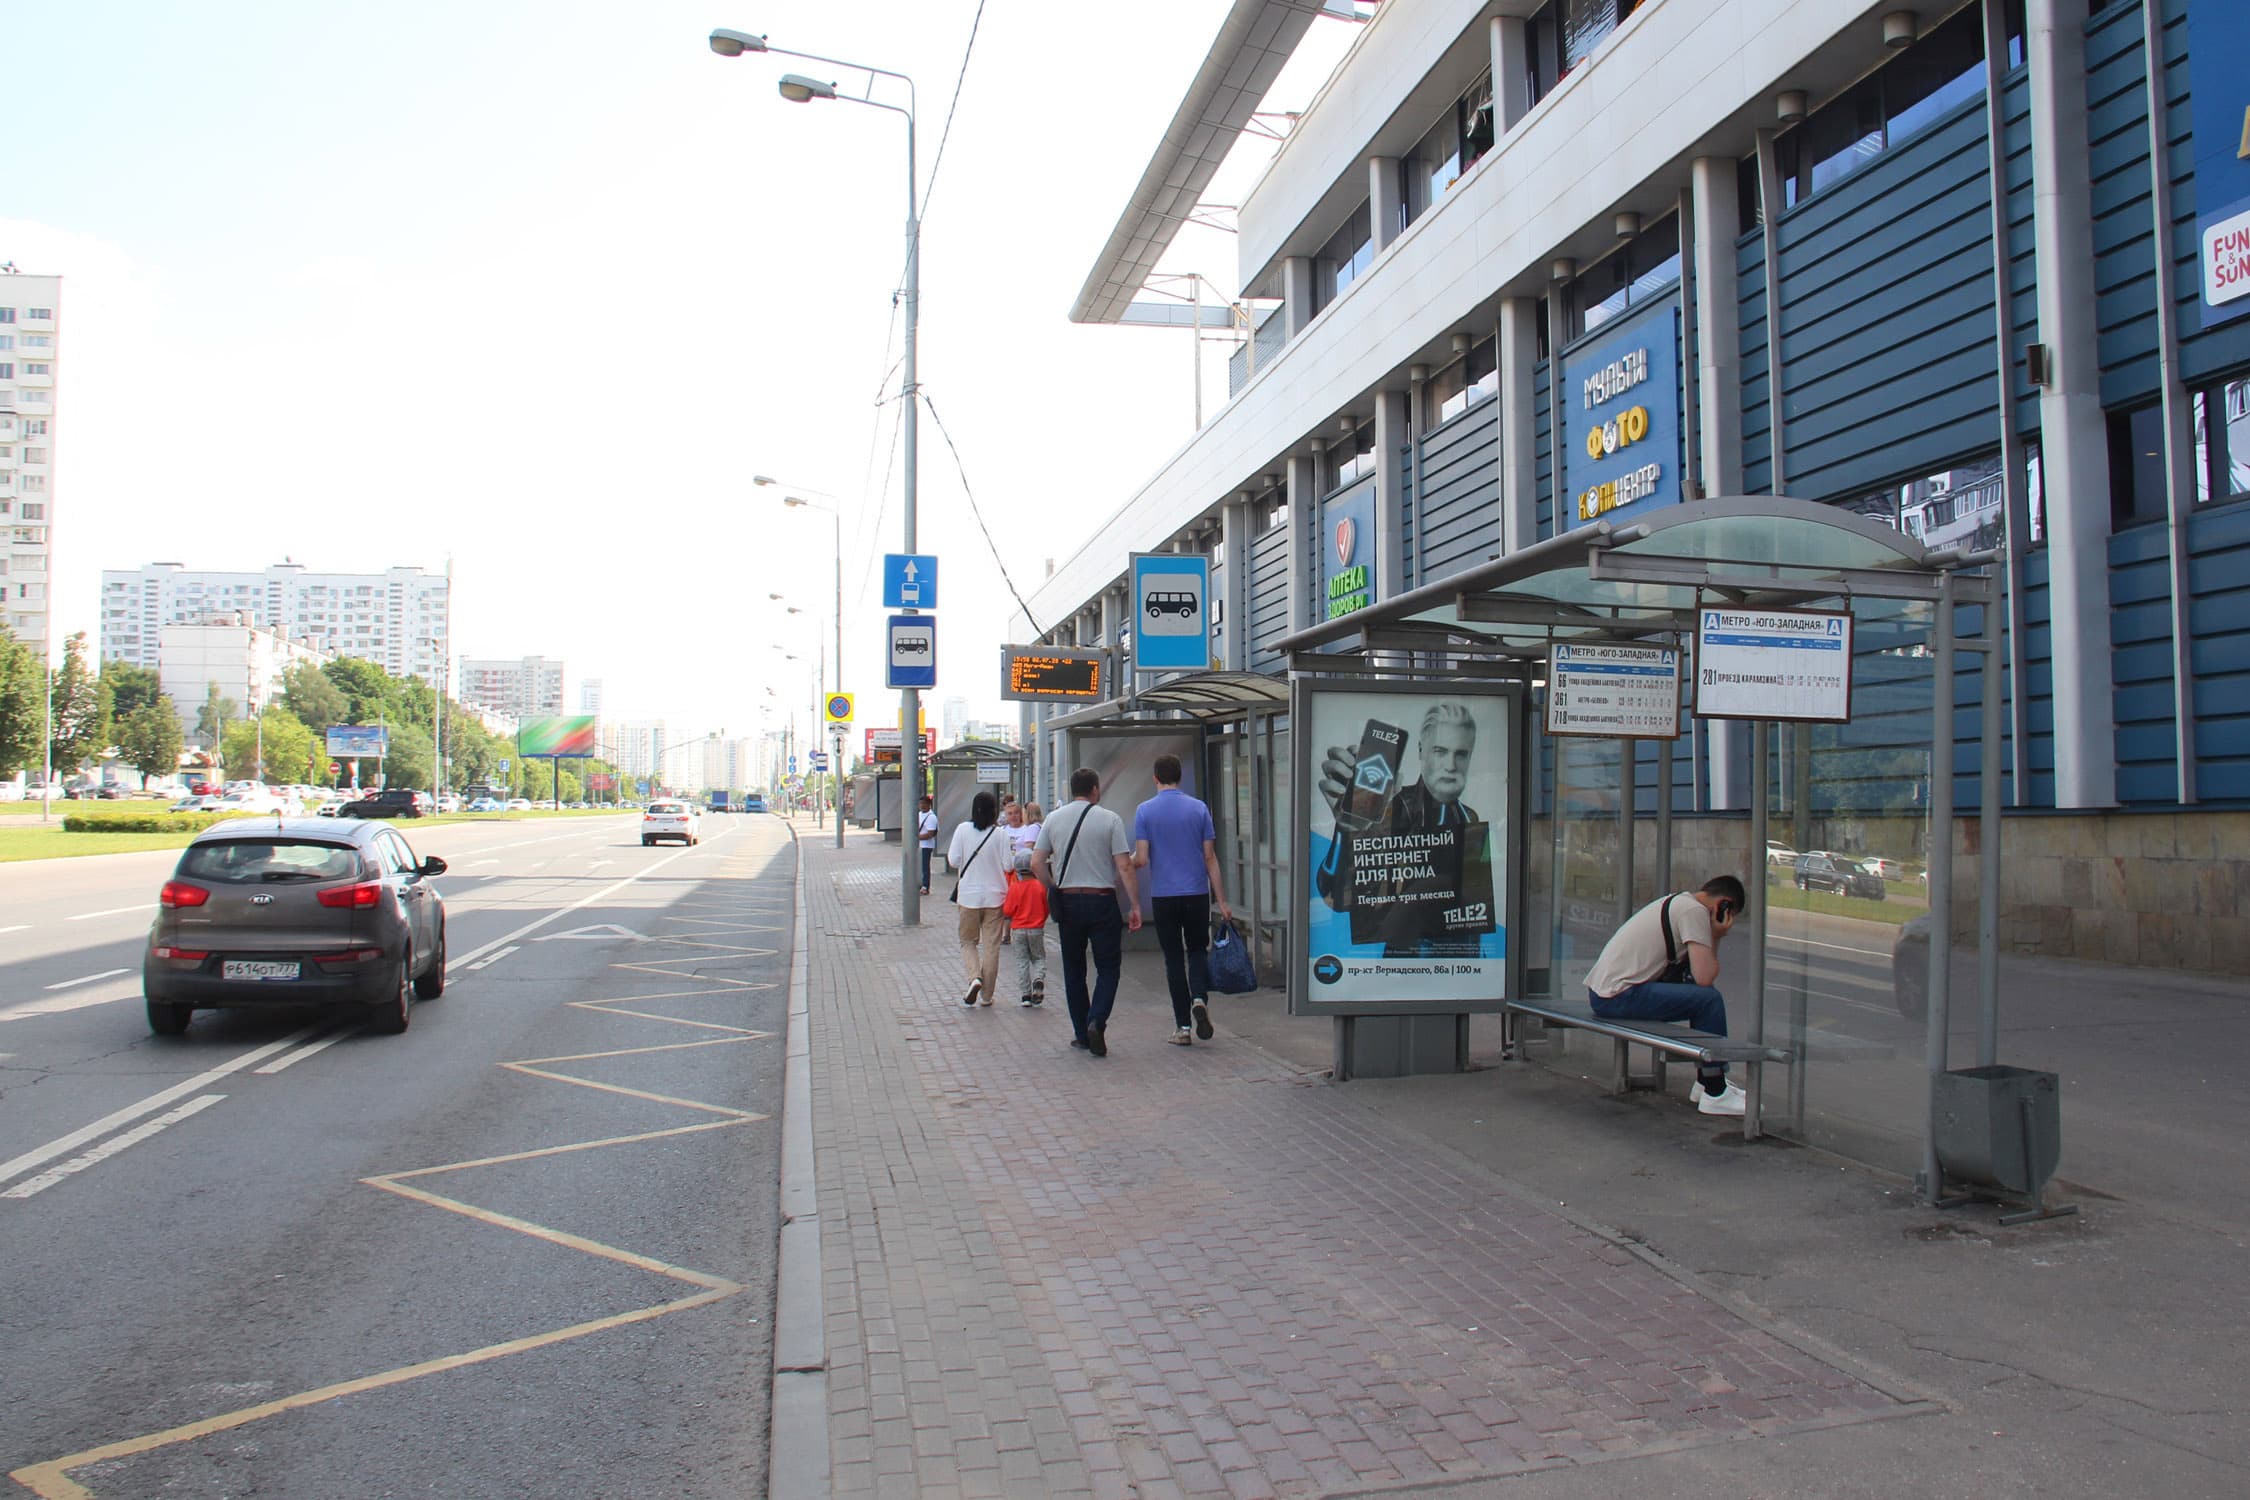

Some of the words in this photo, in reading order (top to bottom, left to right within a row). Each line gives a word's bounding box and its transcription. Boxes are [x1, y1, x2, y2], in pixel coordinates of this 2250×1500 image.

[2214, 226, 2250, 262] FUN
[2228, 252, 2236, 265] &
[1584, 348, 1648, 411] МУЛЬТИ
[1587, 405, 1648, 460] ФОТО
[1578, 463, 1662, 521] КОПИЦЕНТР
[1328, 565, 1368, 600] АПТЕКА
[1721, 615, 1750, 627] МЕТРО
[1752, 617, 1825, 630] «ЮГО-ЗАПАДНАЯ»
[1570, 647, 1595, 658] МЕТРО
[1597, 649, 1659, 661] «ЮГО-ЗАПАДНАЯ»
[1558, 673, 1567, 688] 66
[1703, 668, 1717, 686] 281
[1718, 673, 1740, 683] ПРОЕЗД
[1555, 692, 1568, 707] 361
[1554, 711, 1568, 725] 718
[1371, 729, 1400, 745] TELE2
[1353, 830, 1454, 852] БЕСПЛАТНЫЙ
[1354, 850, 1431, 868] ИНТЕРНЕТ
[1355, 867, 1388, 885] ДЛЯ
[1391, 865, 1436, 882] ДОМА
[252, 896, 271, 904] KIA
[1357, 894, 1396, 907] Первые
[1398, 893, 1418, 905] три
[1419, 890, 1455, 901] месяца
[1443, 903, 1487, 923] TELE2
[1348, 967, 1374, 976] пр-кт
[1375, 965, 1432, 976] Вернадского,
[1434, 965, 1449, 974] 86а
[1456, 965, 1472, 974] 100
